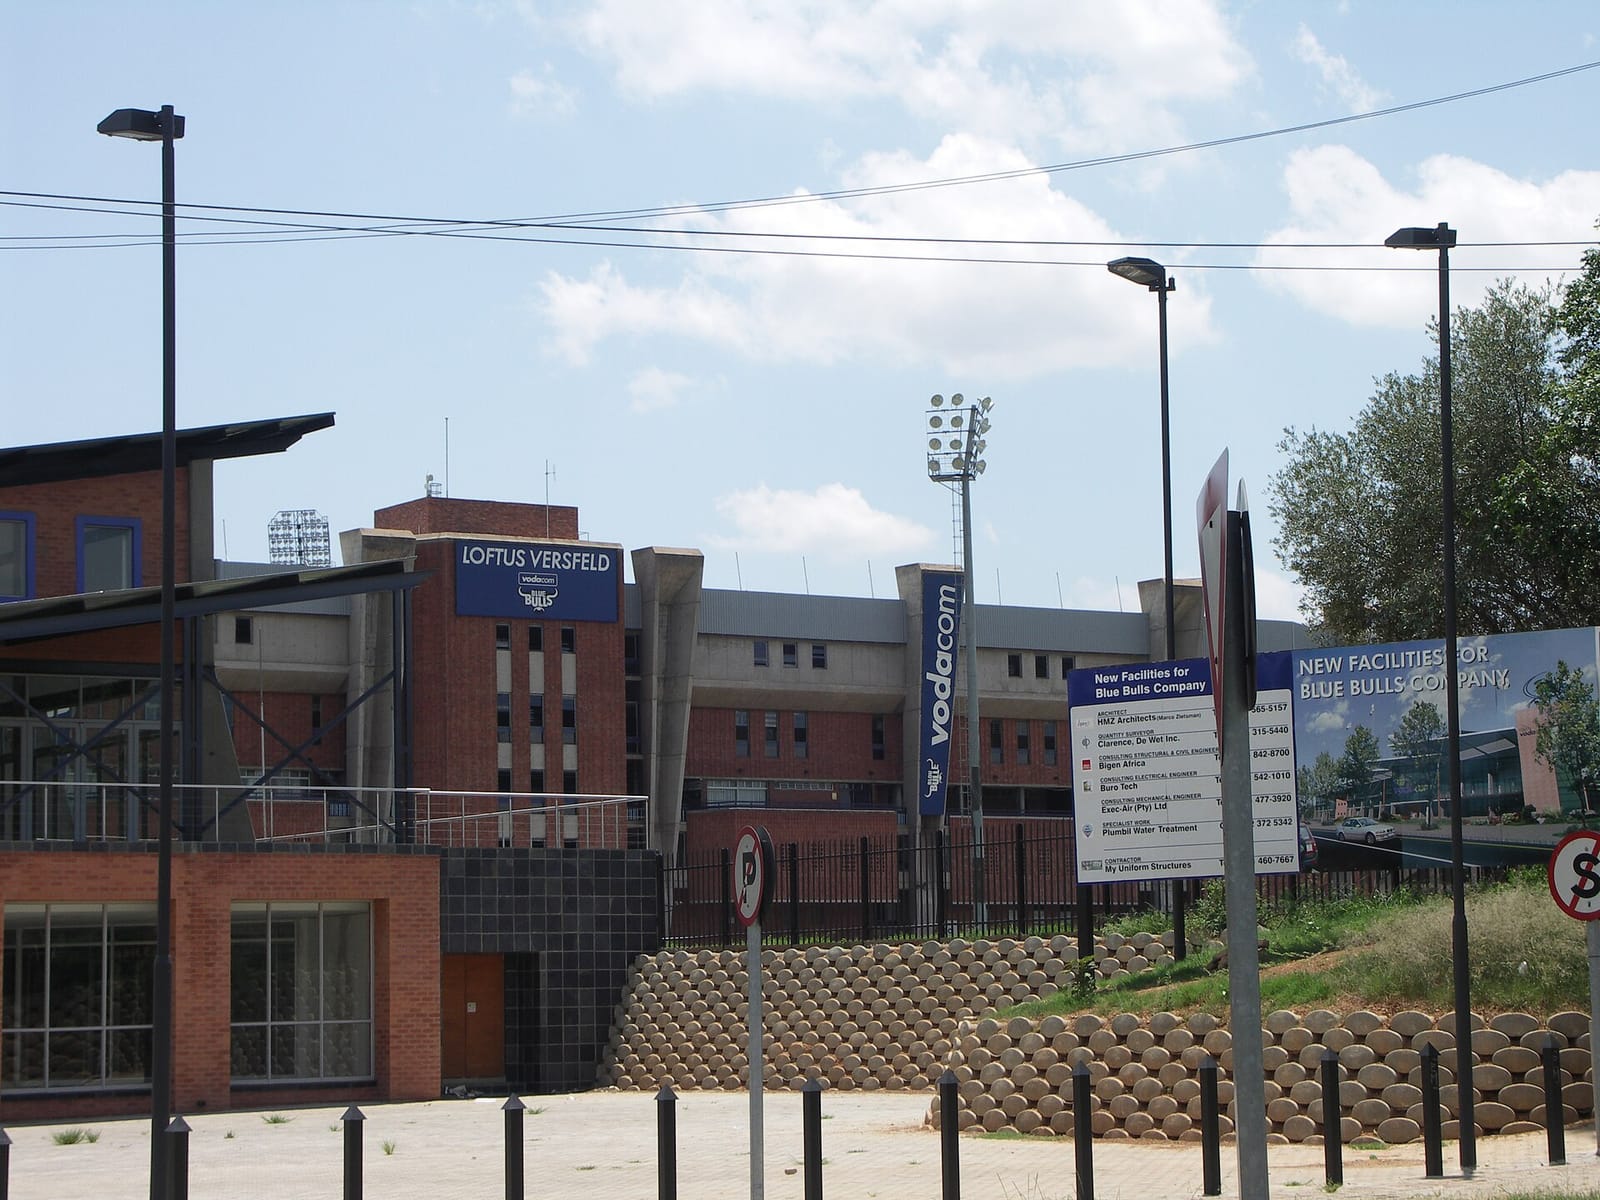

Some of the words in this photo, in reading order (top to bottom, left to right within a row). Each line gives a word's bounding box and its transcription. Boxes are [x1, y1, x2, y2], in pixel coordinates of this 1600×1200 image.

[463, 546, 526, 567] LOFTUS
[530, 550, 610, 572] VERSFELD
[522, 575, 555, 584] vodacom
[525, 594, 553, 607] BULLS
[926, 584, 956, 746] vodacom
[1300, 656, 1344, 676] NEW
[1350, 649, 1444, 672] FACILITIES
[1095, 674, 1118, 685] New
[1122, 669, 1170, 682] Facilities
[1174, 667, 1189, 677] for
[1096, 687, 1120, 699] Blue
[1123, 684, 1150, 696] Bulls
[1153, 681, 1206, 693] Company
[1300, 680, 1345, 700] BLUE
[1350, 676, 1405, 696] BULLS
[1097, 717, 1116, 726] HMZ
[1118, 714, 1156, 724] Architects
[1126, 729, 1154, 737] SURVEYOR
[1252, 726, 1288, 735] 315-5440
[1098, 738, 1134, 749] Clarence,
[1136, 737, 1146, 745] De
[1148, 735, 1164, 744] Wet
[1099, 753, 1133, 761] CONSULTING
[1134, 751, 1169, 759] STRUCTURAL
[1253, 749, 1290, 758] 842-8700
[1099, 761, 1121, 771] Bigen
[1123, 760, 1146, 768] Africa
[1100, 776, 1134, 784] CONSULTING
[1254, 772, 1290, 781] 542-1010
[1100, 784, 1119, 792] Buro
[1136, 795, 1172, 803] MECHANICAL
[1255, 795, 1291, 803] 477-3920
[1102, 805, 1133, 814] Exec-Air
[1134, 804, 1152, 813] (Pty)
[1154, 802, 1167, 810] Ltd
[1274, 818, 1293, 826] 5342
[1103, 827, 1132, 836] Plumbil
[1133, 826, 1155, 835] Water
[1159, 824, 1198, 833] Treatment
[1258, 856, 1294, 864] 460-7667
[1105, 865, 1117, 874] My
[1118, 863, 1149, 872] Uniform
[1151, 861, 1192, 870] Structures
[1571, 853, 1600, 898] S
